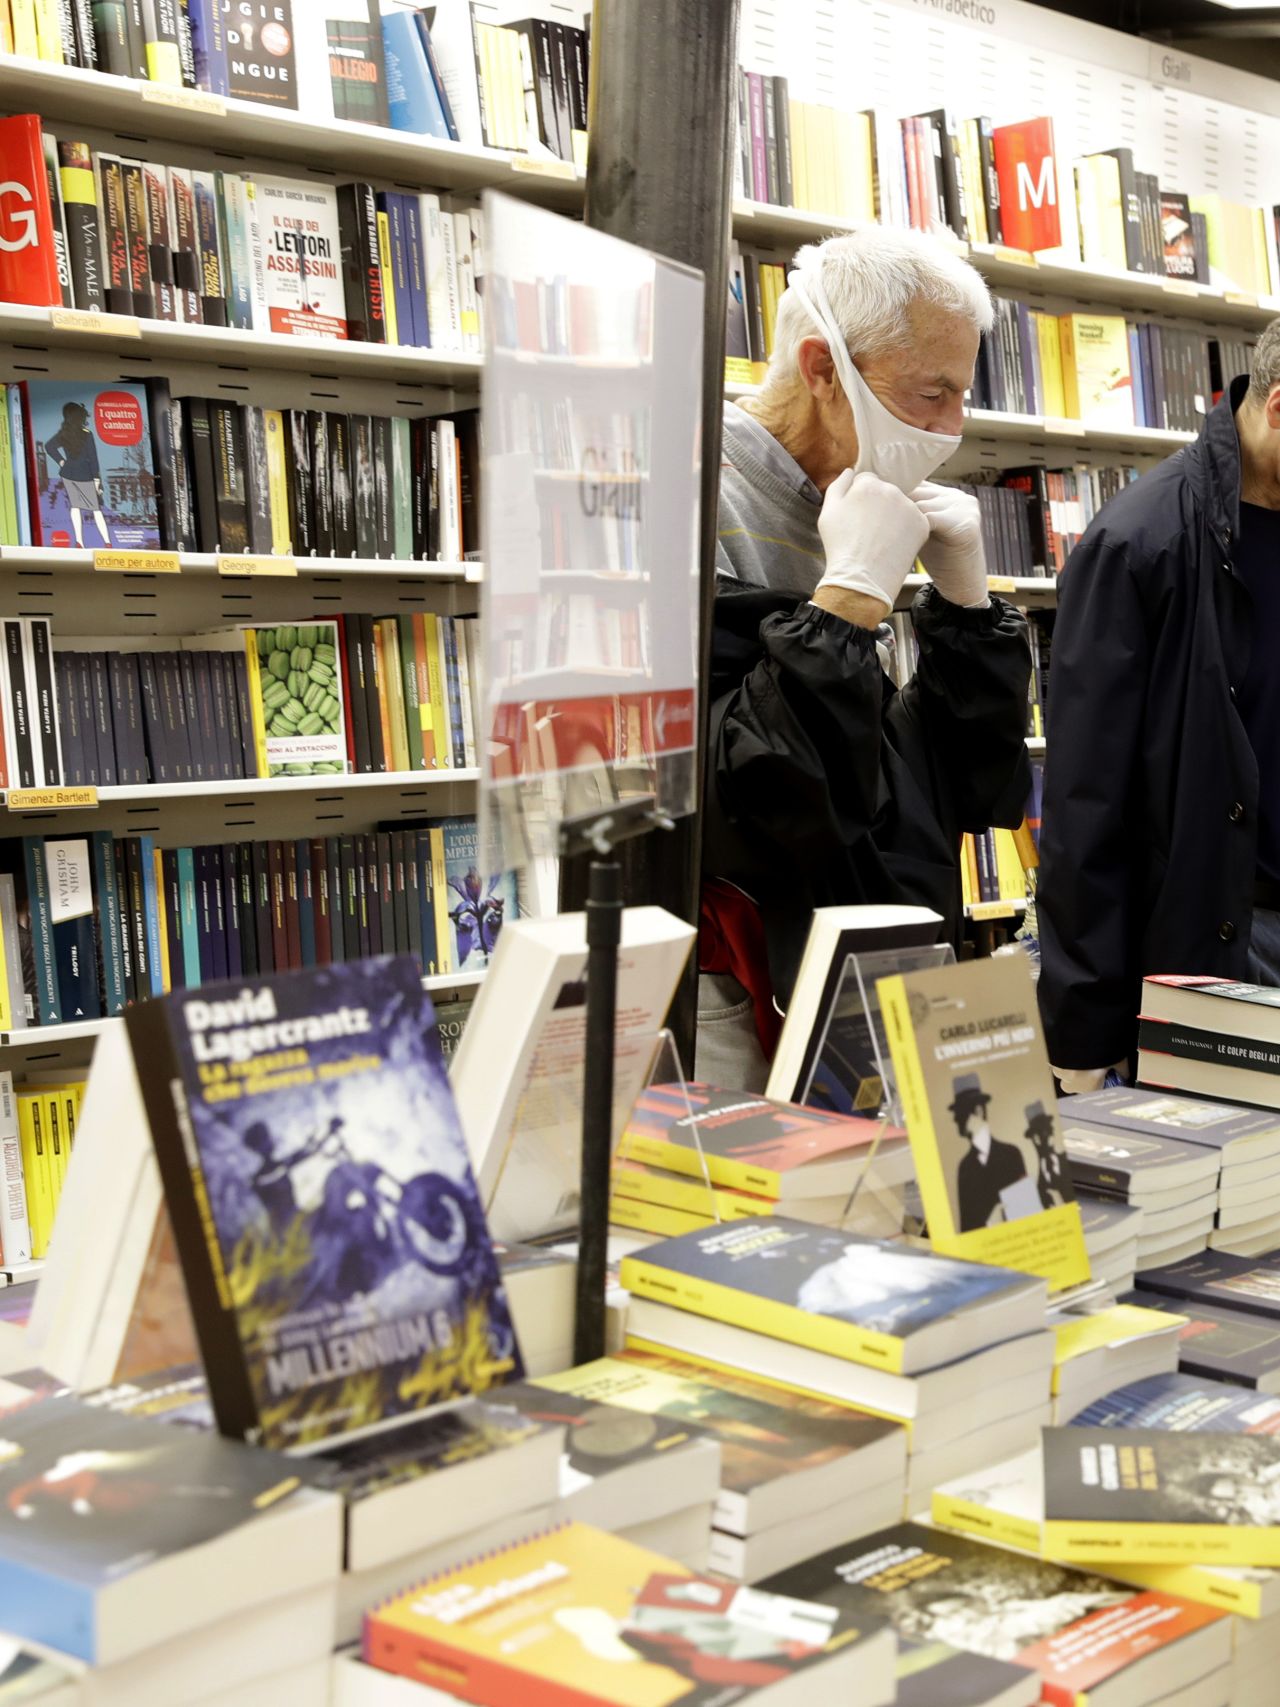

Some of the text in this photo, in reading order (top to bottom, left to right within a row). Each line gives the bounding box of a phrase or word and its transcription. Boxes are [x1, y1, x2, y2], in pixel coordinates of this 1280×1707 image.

[232, 61, 289, 82] NGUE
[1017, 156, 1056, 211] M
[0, 181, 39, 252] G
[273, 215, 320, 232] IL CLUB DEI
[81, 222, 97, 244] VIA
[275, 230, 331, 258] LETTORI
[53, 230, 69, 287] BIANCO
[267, 254, 337, 280] ASSASSINI
[84, 257, 99, 296] MALE
[368, 267, 384, 320] CRISIS
[54, 313, 101, 329] Galbraith
[103, 421, 135, 431] cantoni
[105, 410, 137, 422] quattro
[224, 410, 237, 490] ELIZABETH GEORGE
[95, 556, 175, 570] ordine per autore
[222, 560, 257, 573] George
[11, 792, 91, 805] Gimenez Bartlett
[57, 849, 69, 908] GRISHAM
[68, 862, 79, 893] JOHN
[39, 902, 49, 943] L'AVVOCATO
[107, 896, 118, 936] L'AVVOCATO
[111, 937, 119, 957] DEGLI
[121, 924, 129, 951] GRANDE
[44, 944, 52, 965] DEGLI
[71, 946, 79, 977] TRILOGY
[123, 952, 131, 977] TRUFFA
[46, 965, 55, 1004] INNOCENTI
[113, 958, 121, 995] INNOCENTI
[184, 986, 276, 1032] David
[191, 1006, 372, 1063] Lagercrantz
[940, 1012, 1027, 1041] CARLO LUCARELLI
[1171, 1037, 1188, 1046] LINDA
[1217, 1044, 1226, 1054] LE
[1227, 1046, 1247, 1058] COLPE
[1249, 1049, 1267, 1061] DEGLI
[266, 1314, 435, 1396] MILLENNIUM
